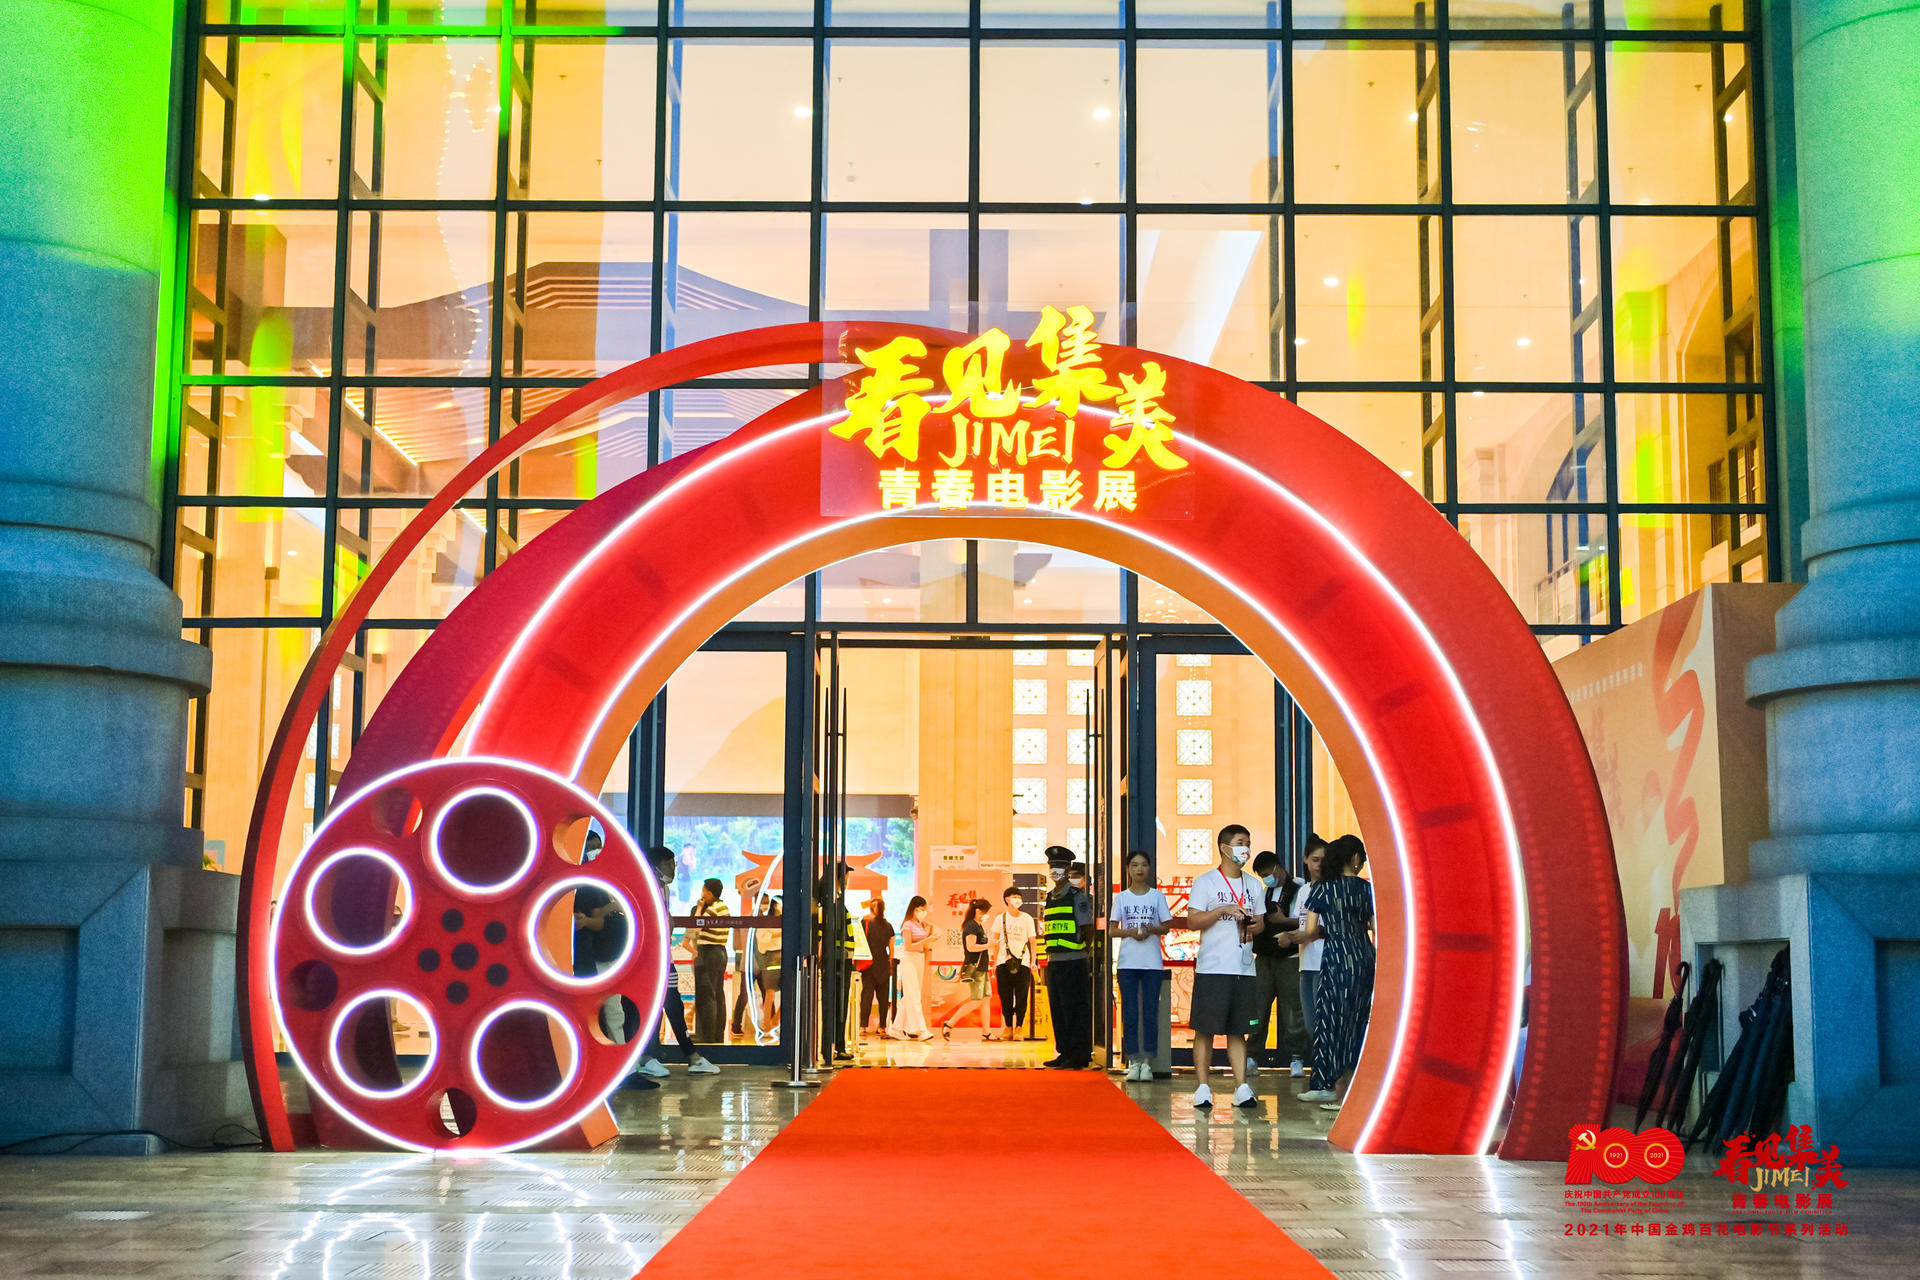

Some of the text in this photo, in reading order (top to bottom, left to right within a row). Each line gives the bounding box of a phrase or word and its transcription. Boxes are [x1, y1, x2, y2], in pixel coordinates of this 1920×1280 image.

[829, 305, 1189, 470] 看见集美
[938, 413, 1075, 467] JIMEI
[879, 467, 1138, 512] 青春电影展
